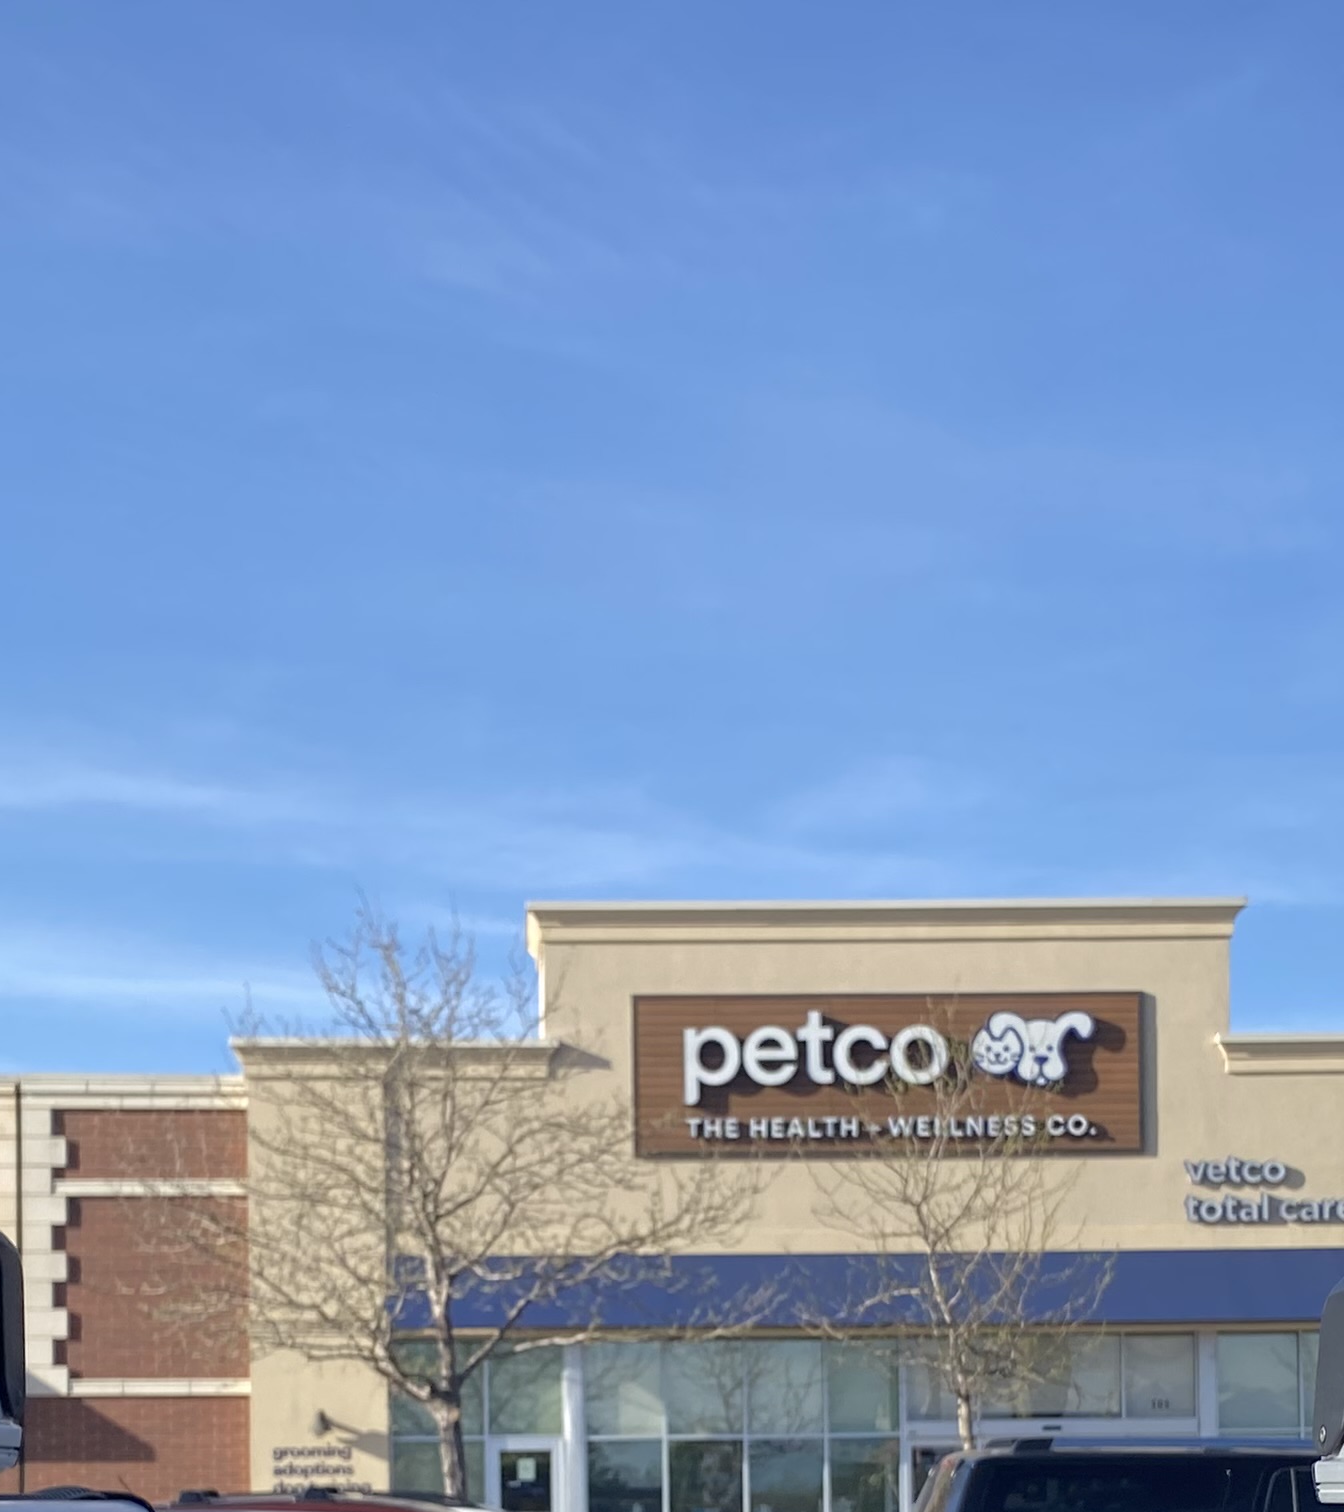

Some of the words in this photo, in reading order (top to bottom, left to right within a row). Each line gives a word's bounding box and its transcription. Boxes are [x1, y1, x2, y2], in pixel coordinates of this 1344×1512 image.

[682, 1010, 947, 1107] petco
[685, 1115, 740, 1139] THE
[748, 1115, 860, 1139] HEALTH
[1047, 1113, 1098, 1137] CO.
[1184, 1155, 1287, 1185] vetco
[1184, 1191, 1270, 1224] total
